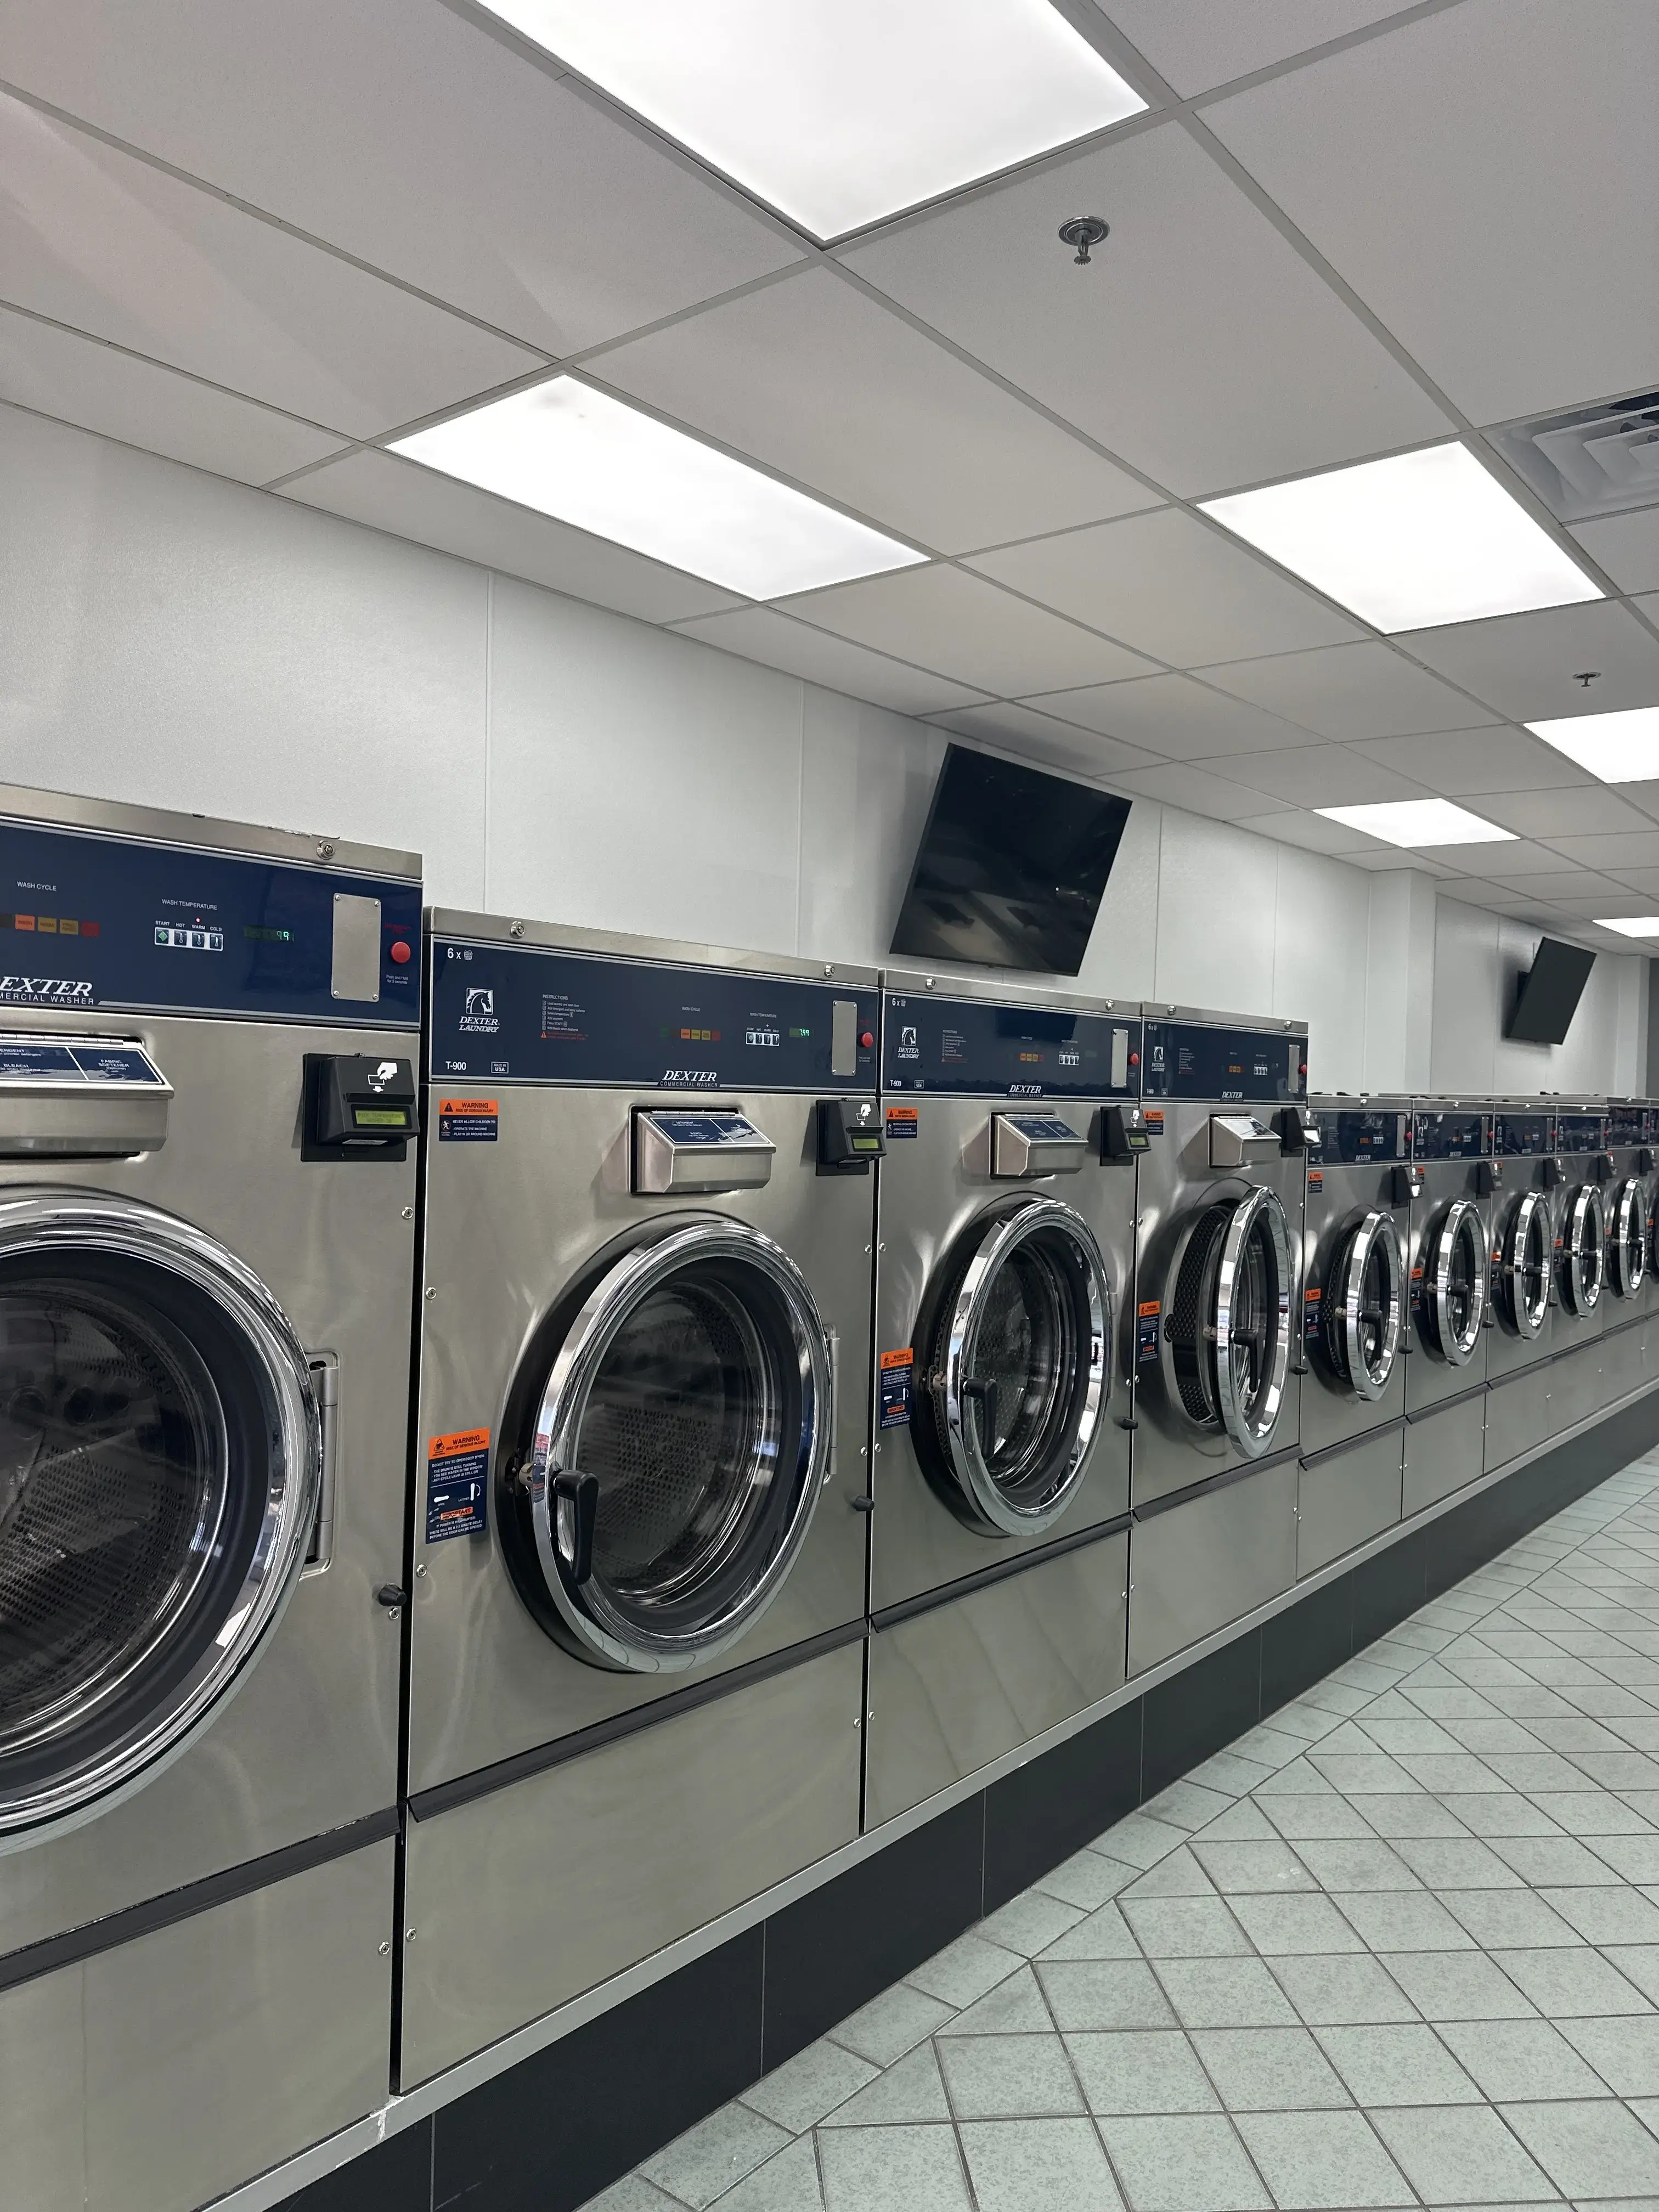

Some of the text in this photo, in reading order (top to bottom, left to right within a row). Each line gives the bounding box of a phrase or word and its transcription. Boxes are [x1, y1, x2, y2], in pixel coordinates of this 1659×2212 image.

[179, 901, 218, 910] TEMPERATURE
[447, 947, 454, 959] 6
[0, 976, 93, 997] EXTER
[50, 995, 94, 1005] WASHER
[892, 998, 896, 1006] 6
[459, 1016, 499, 1025] DEXTER
[459, 1025, 499, 1033] LAUNDRY
[445, 1061, 466, 1070] T-900
[662, 1070, 717, 1082] DEXTER
[1009, 1085, 1041, 1093] DEXTER
[453, 1435, 480, 1445] WARNING
